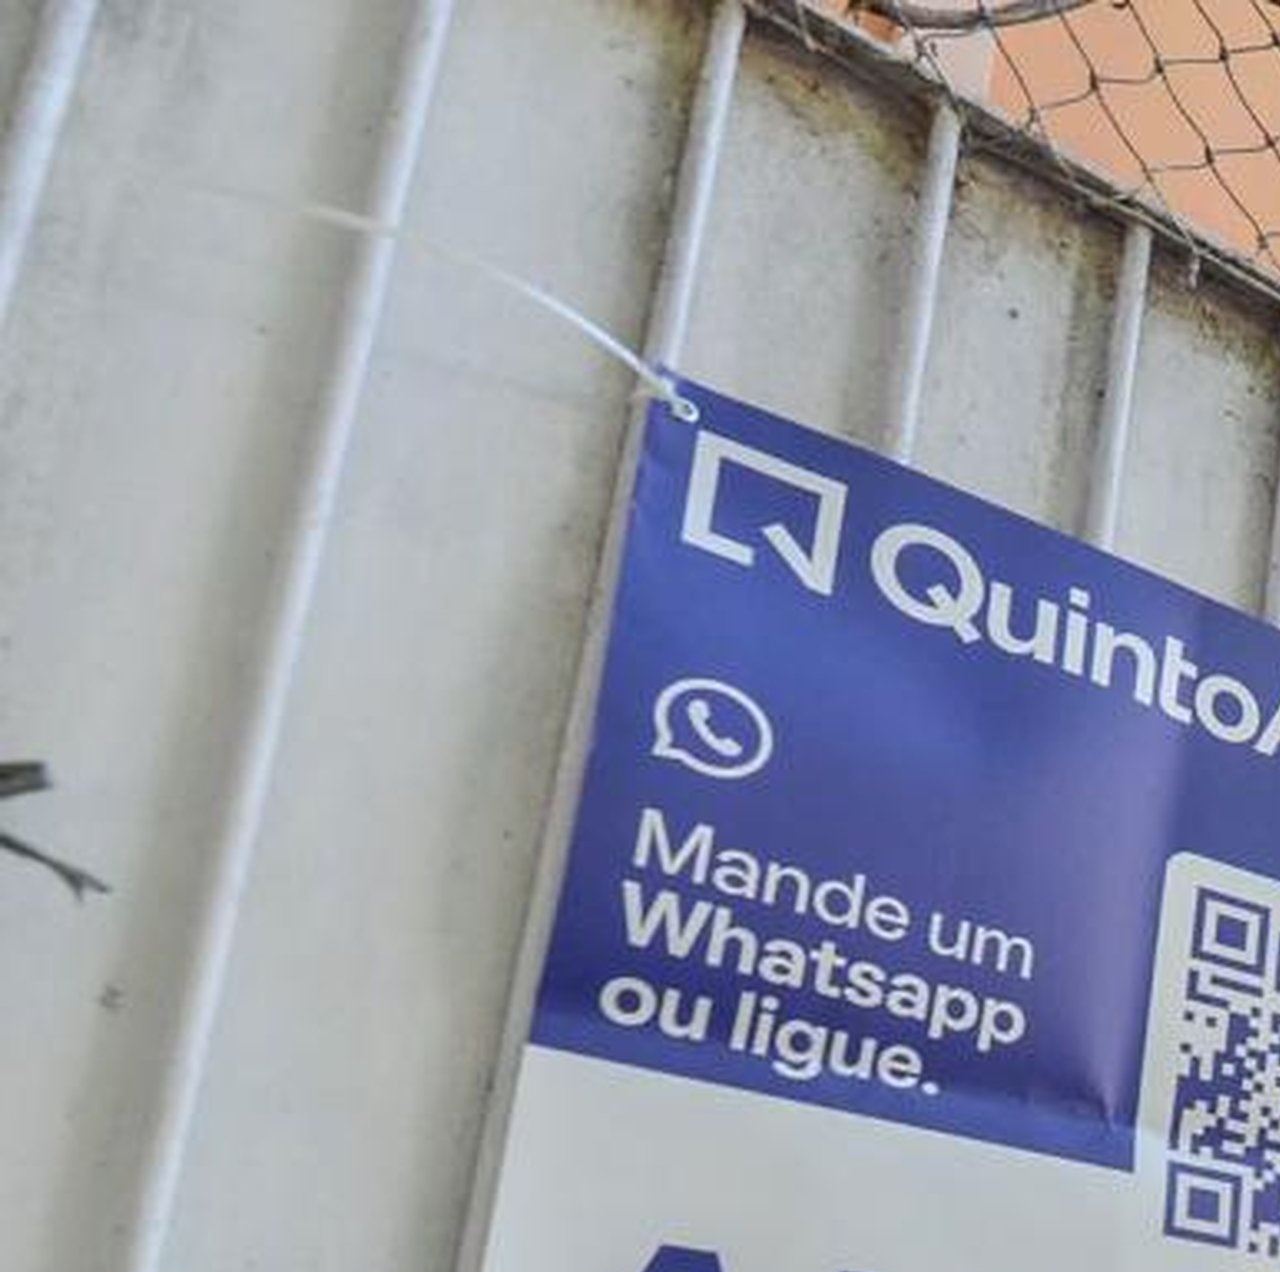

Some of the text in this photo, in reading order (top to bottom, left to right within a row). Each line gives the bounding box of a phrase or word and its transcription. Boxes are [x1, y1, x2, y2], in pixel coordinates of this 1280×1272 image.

[619, 880, 1027, 1053] Whatsapp
[631, 806, 1035, 980] Mande um
[600, 975, 940, 1096] ou ligue.
